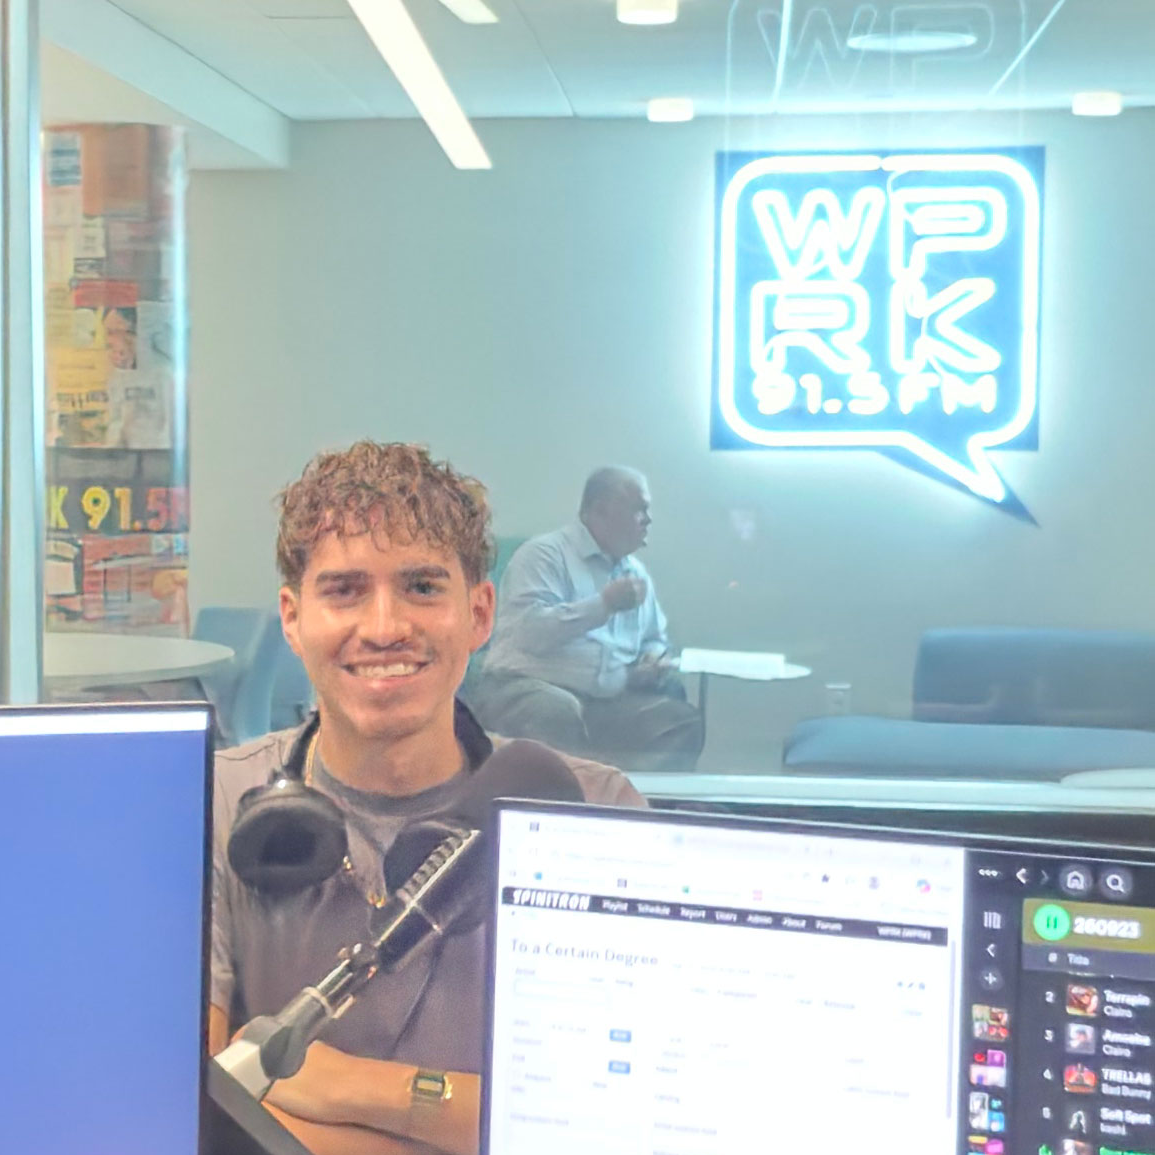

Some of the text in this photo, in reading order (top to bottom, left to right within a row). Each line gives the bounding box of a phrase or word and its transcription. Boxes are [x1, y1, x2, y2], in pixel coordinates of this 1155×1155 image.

[513, 888, 591, 911] SPINITRON
[511, 938, 659, 967] To a Certain Degree
